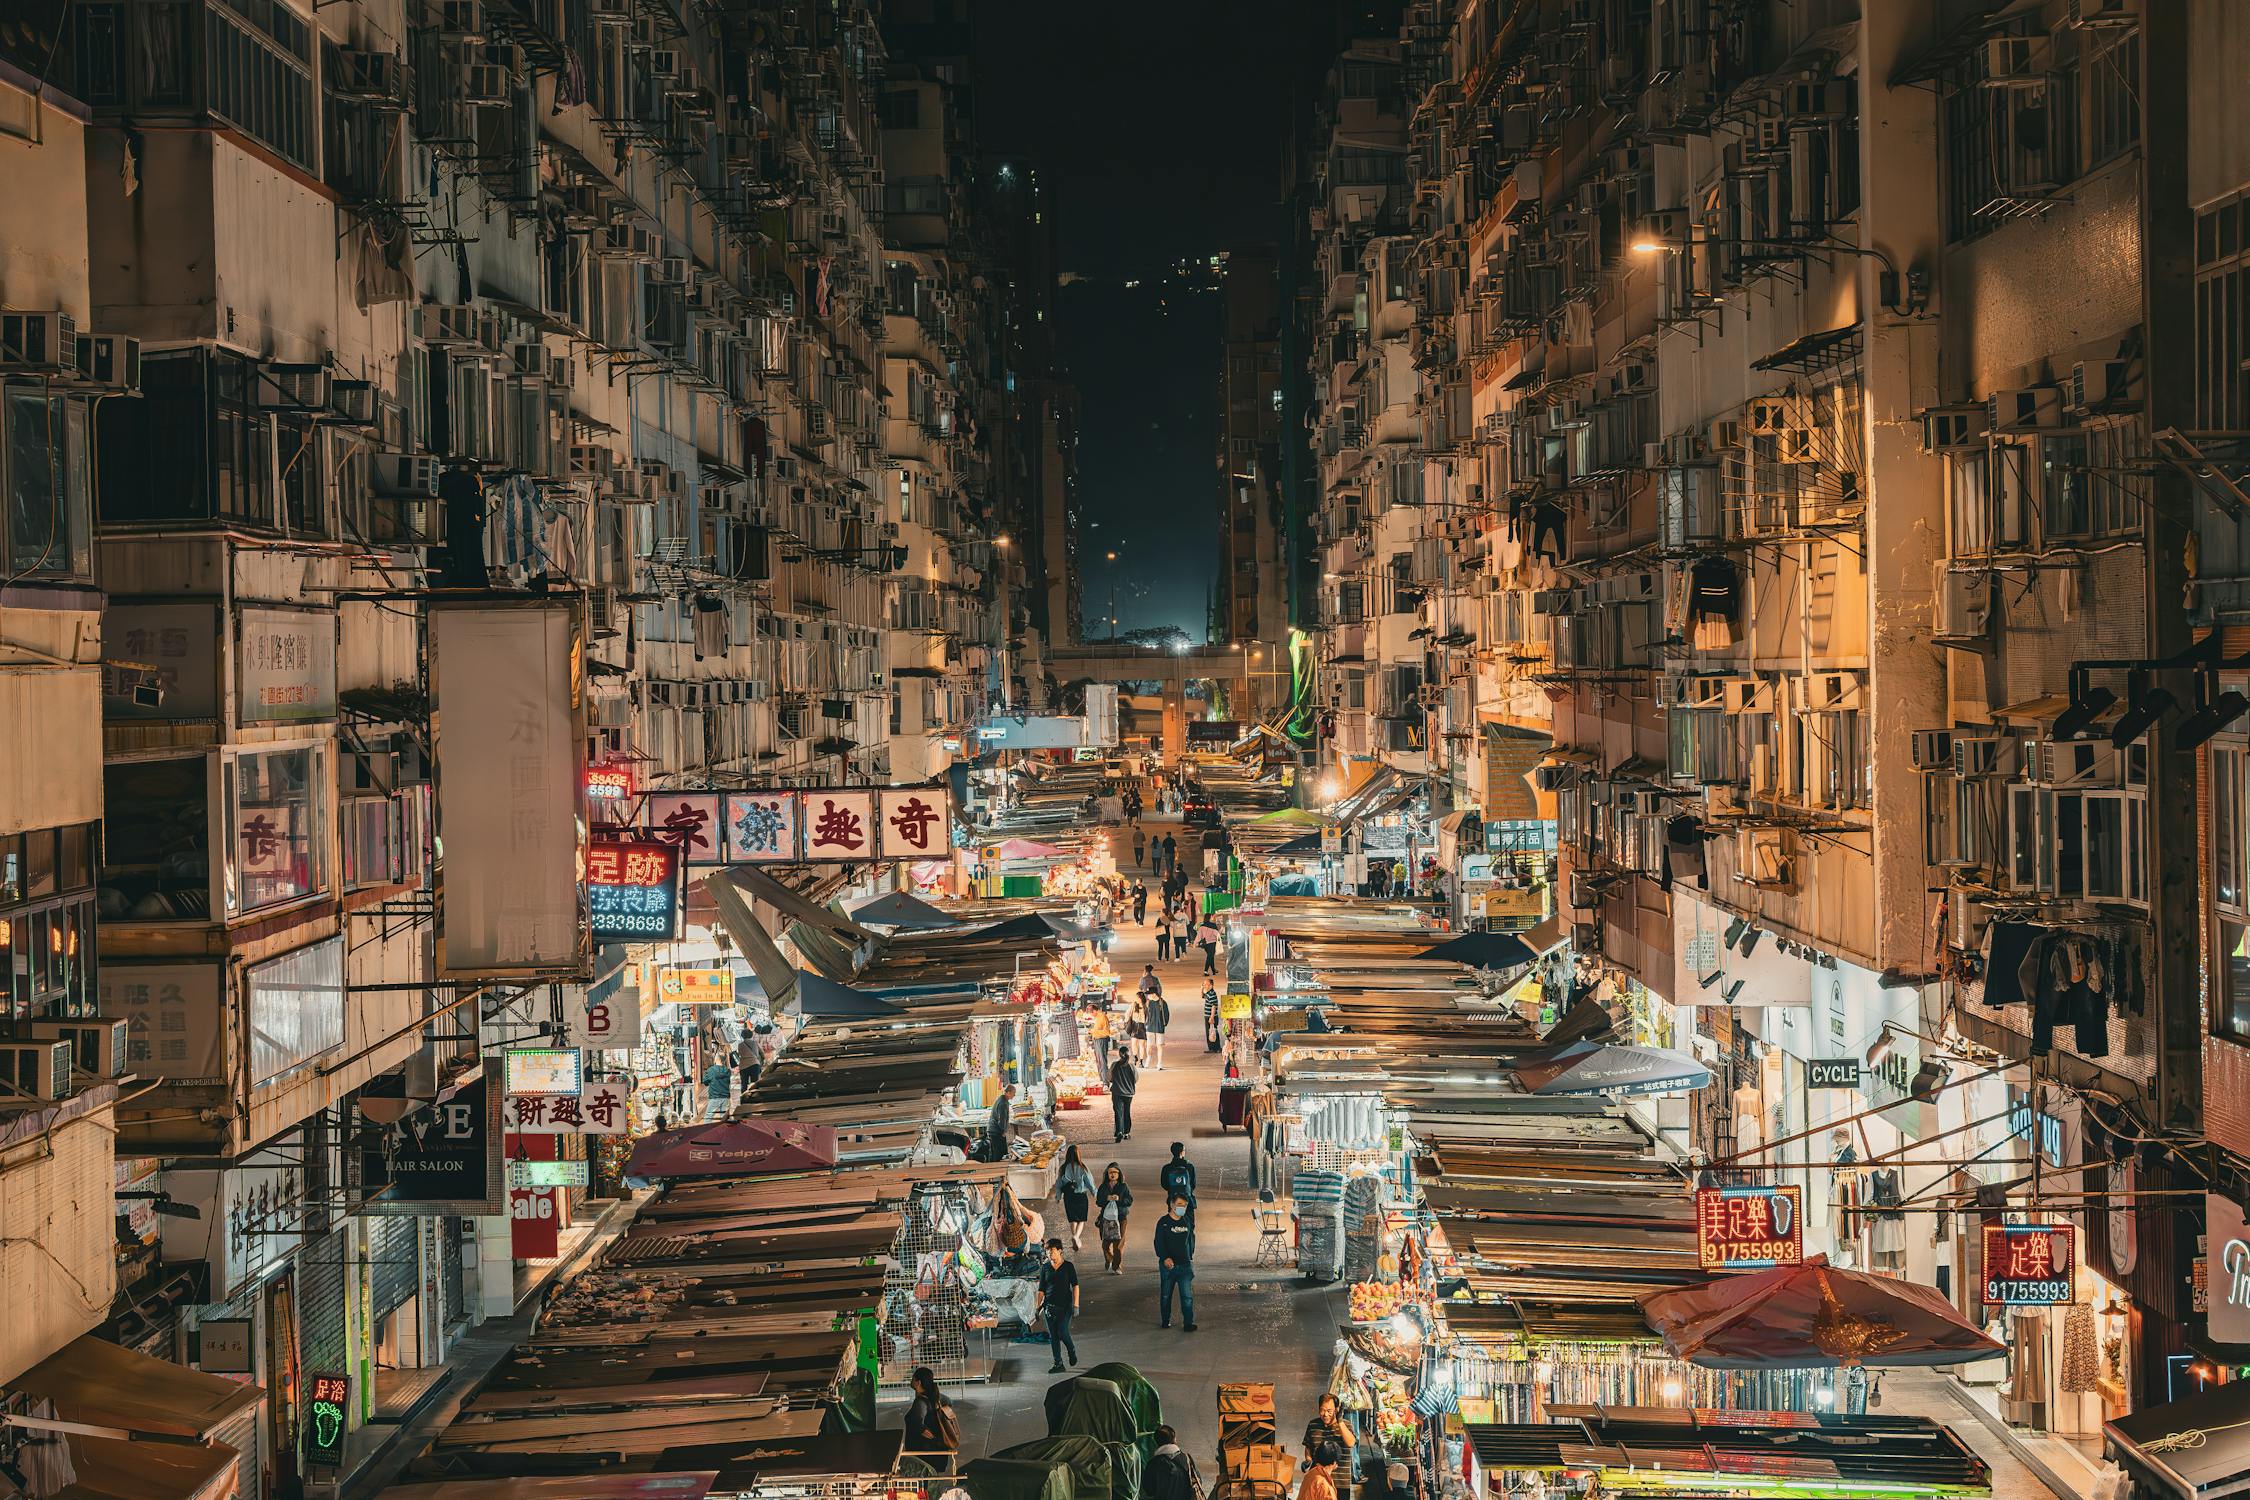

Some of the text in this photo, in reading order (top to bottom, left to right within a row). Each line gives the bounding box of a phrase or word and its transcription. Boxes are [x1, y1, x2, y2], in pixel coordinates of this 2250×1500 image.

[590, 886, 667, 912] 宗按摩
[1811, 1065, 1858, 1083] CYCLE
[504, 1088, 622, 1128] 奇趣餅
[386, 1160, 464, 1171] HAIR SALON
[511, 1194, 553, 1220] ale
[1706, 1194, 1767, 1240] 美足樂
[1706, 1241, 1795, 1261] 91755993
[1988, 1281, 2069, 1300] 91755993
